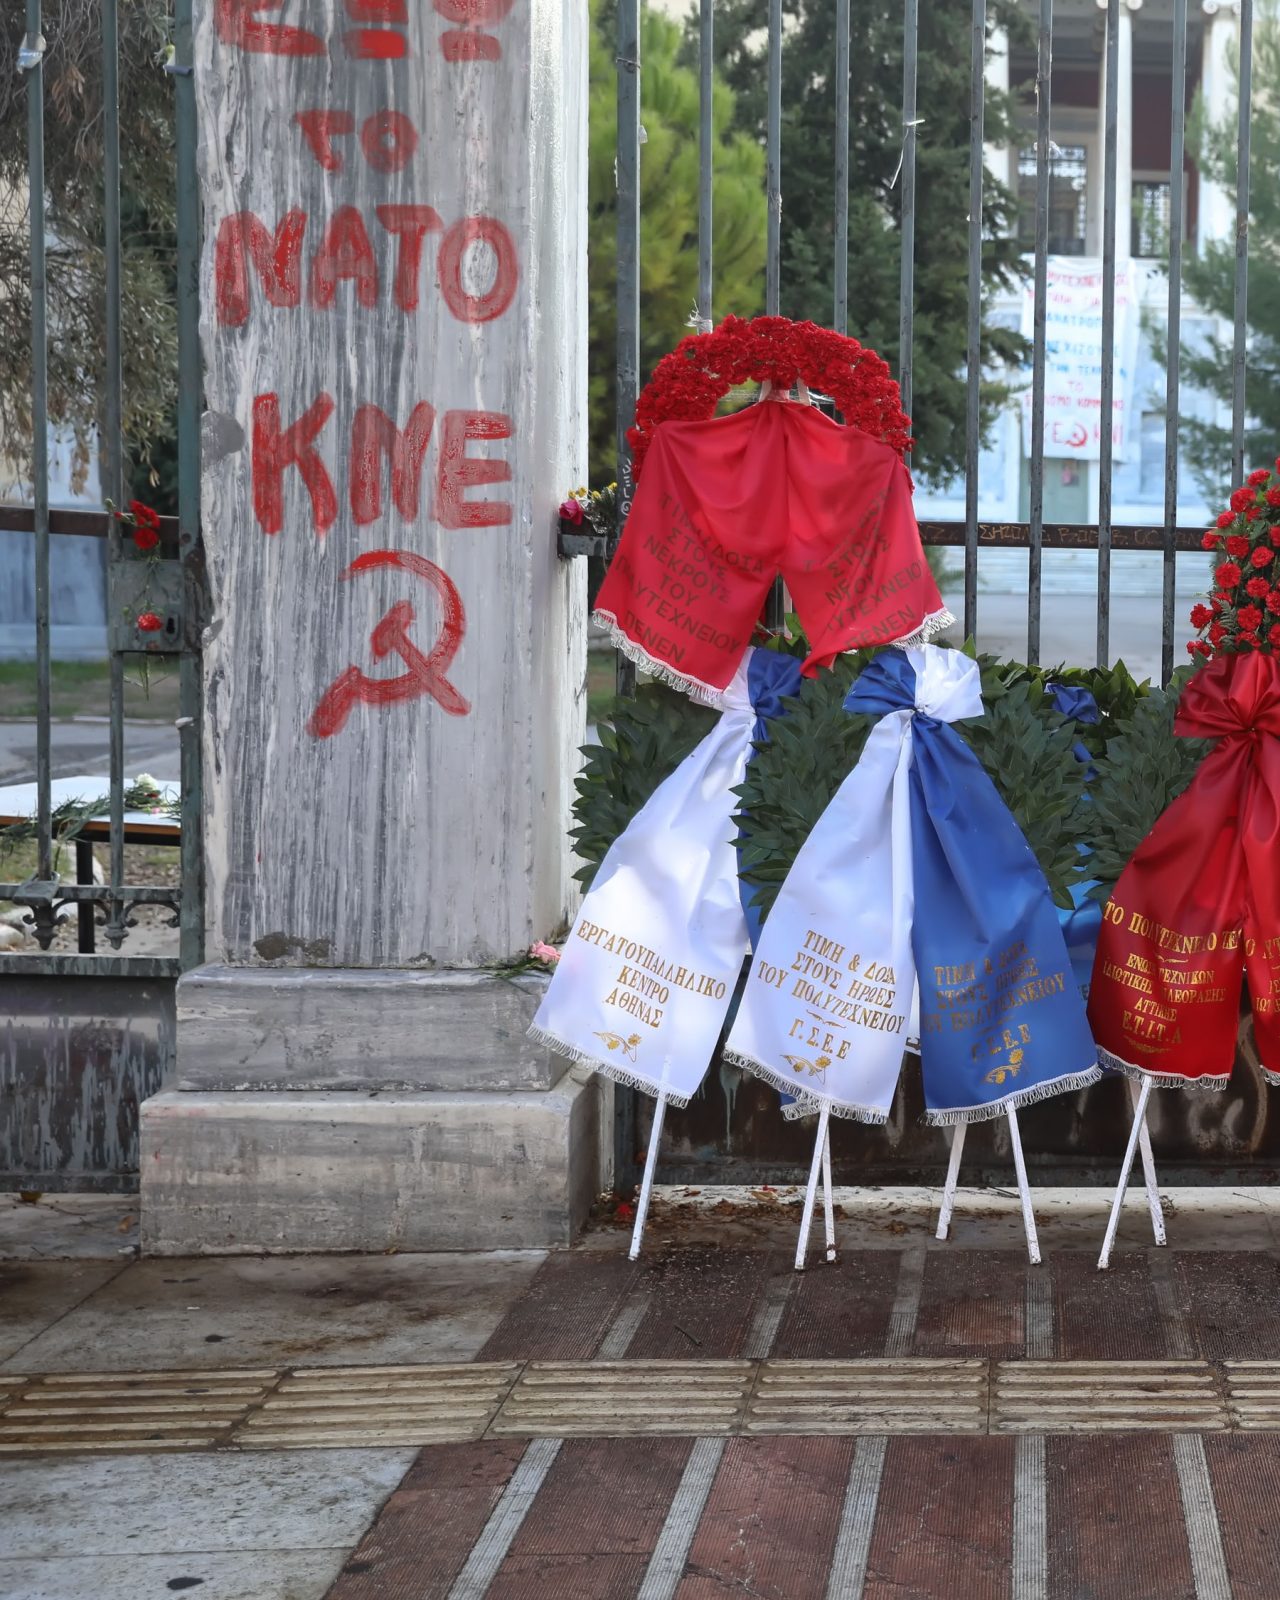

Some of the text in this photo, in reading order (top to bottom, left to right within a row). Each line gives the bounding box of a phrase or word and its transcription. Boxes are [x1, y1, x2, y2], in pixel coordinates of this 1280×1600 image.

[659, 573, 699, 607] ΤΟΥ
[576, 919, 726, 1000] ΕΡΓΑΤΟΥΠΑΛΛΗΛΙΚΟ
[803, 930, 846, 964] ΤΙΜΗ
[848, 953, 861, 972] &
[617, 965, 670, 1005] ΚΕΝΤΡΟ
[757, 961, 906, 1034] ΤΟΥ ΠΟΛΥΤΕΧΝΕΙΟΥ
[791, 952, 896, 1009] ΣΤΟΥΣ ΗΡΩΕΣ
[605, 987, 663, 1028] ΑΘΗΝΑΣ
